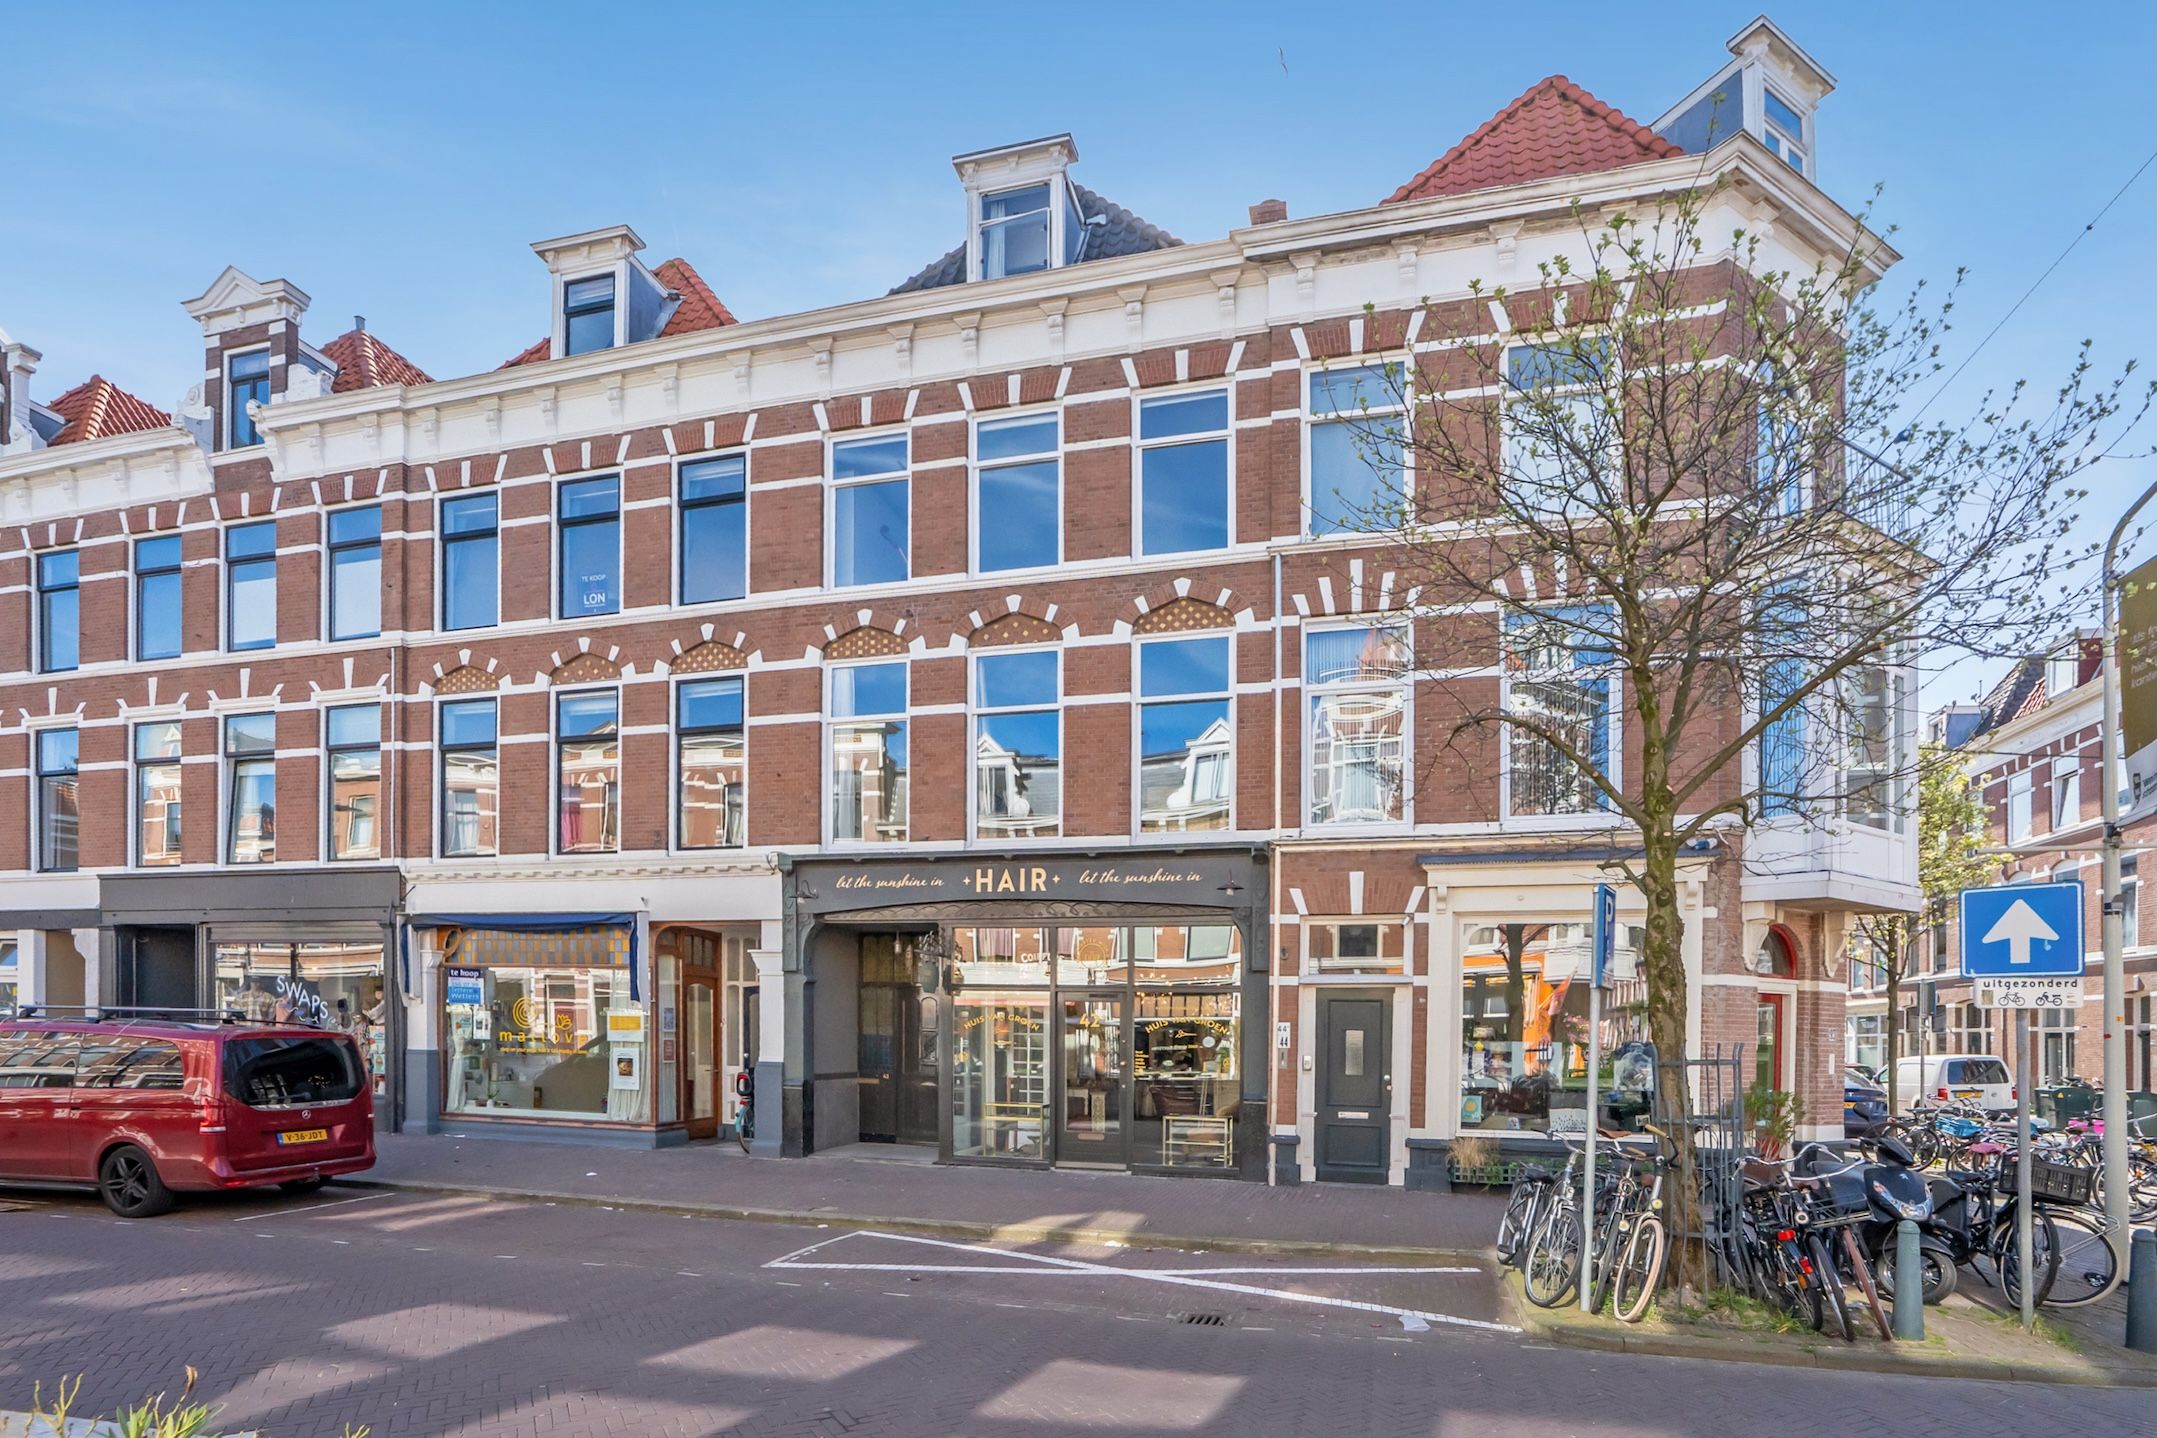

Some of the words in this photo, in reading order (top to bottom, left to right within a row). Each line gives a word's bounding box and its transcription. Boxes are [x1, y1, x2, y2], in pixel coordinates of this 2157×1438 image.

[583, 593, 606, 605] LON
[836, 875, 853, 888] let
[853, 874, 873, 888] the
[875, 873, 928, 889] sunshine
[930, 877, 944, 886] in
[975, 867, 1047, 893] HAIR
[1079, 869, 1098, 884] let
[1099, 868, 1121, 884] the
[1123, 867, 1183, 884] sunshine
[1186, 871, 1202, 882] in
[1605, 894, 1614, 937] P
[450, 969, 459, 977] te
[1983, 979, 2078, 990] uitgezonderd
[276, 974, 329, 1019] SWAPS
[963, 1015, 985, 1030] HUIS
[1007, 1014, 1040, 1032] GROEN
[1079, 1013, 1100, 1028] 42
[1145, 1019, 1169, 1034] HUIS
[1193, 1017, 1228, 1034] GROEN
